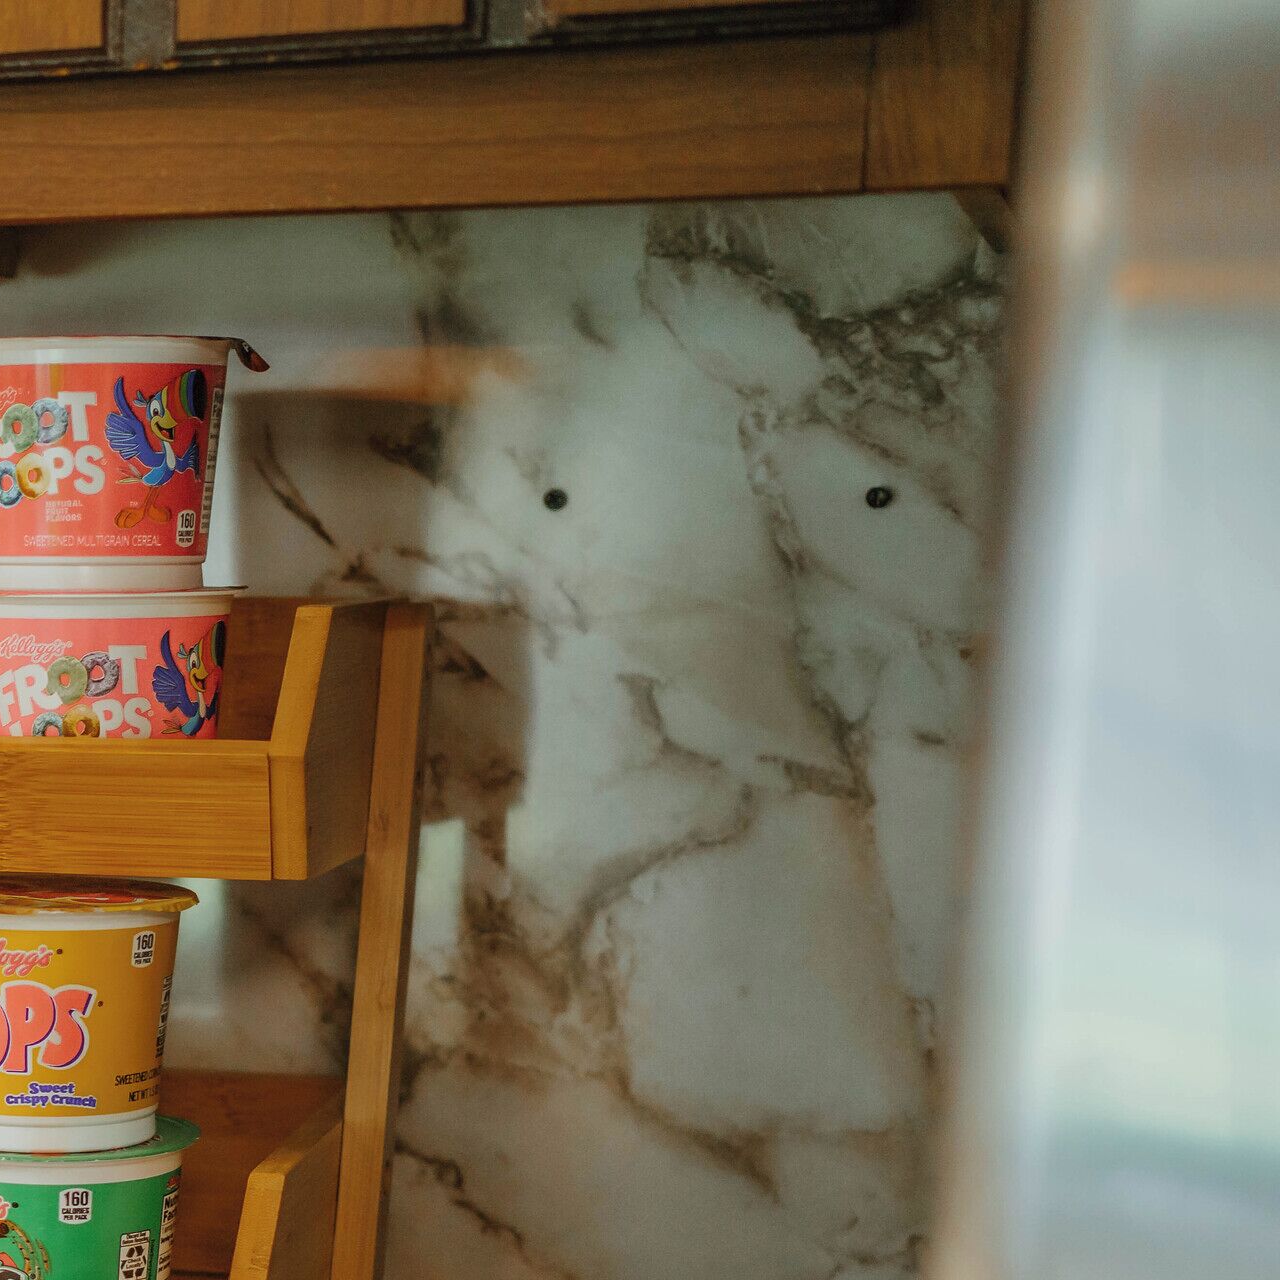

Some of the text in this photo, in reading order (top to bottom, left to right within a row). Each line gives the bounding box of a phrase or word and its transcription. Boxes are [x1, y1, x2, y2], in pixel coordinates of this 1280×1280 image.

[179, 512, 195, 529] 160
[132, 534, 161, 547] CEREAL
[136, 933, 154, 951] 160
[29, 1083, 75, 1095] Sweet
[6, 1094, 97, 1108] Crispy Crunch
[63, 1190, 89, 1206] 160
